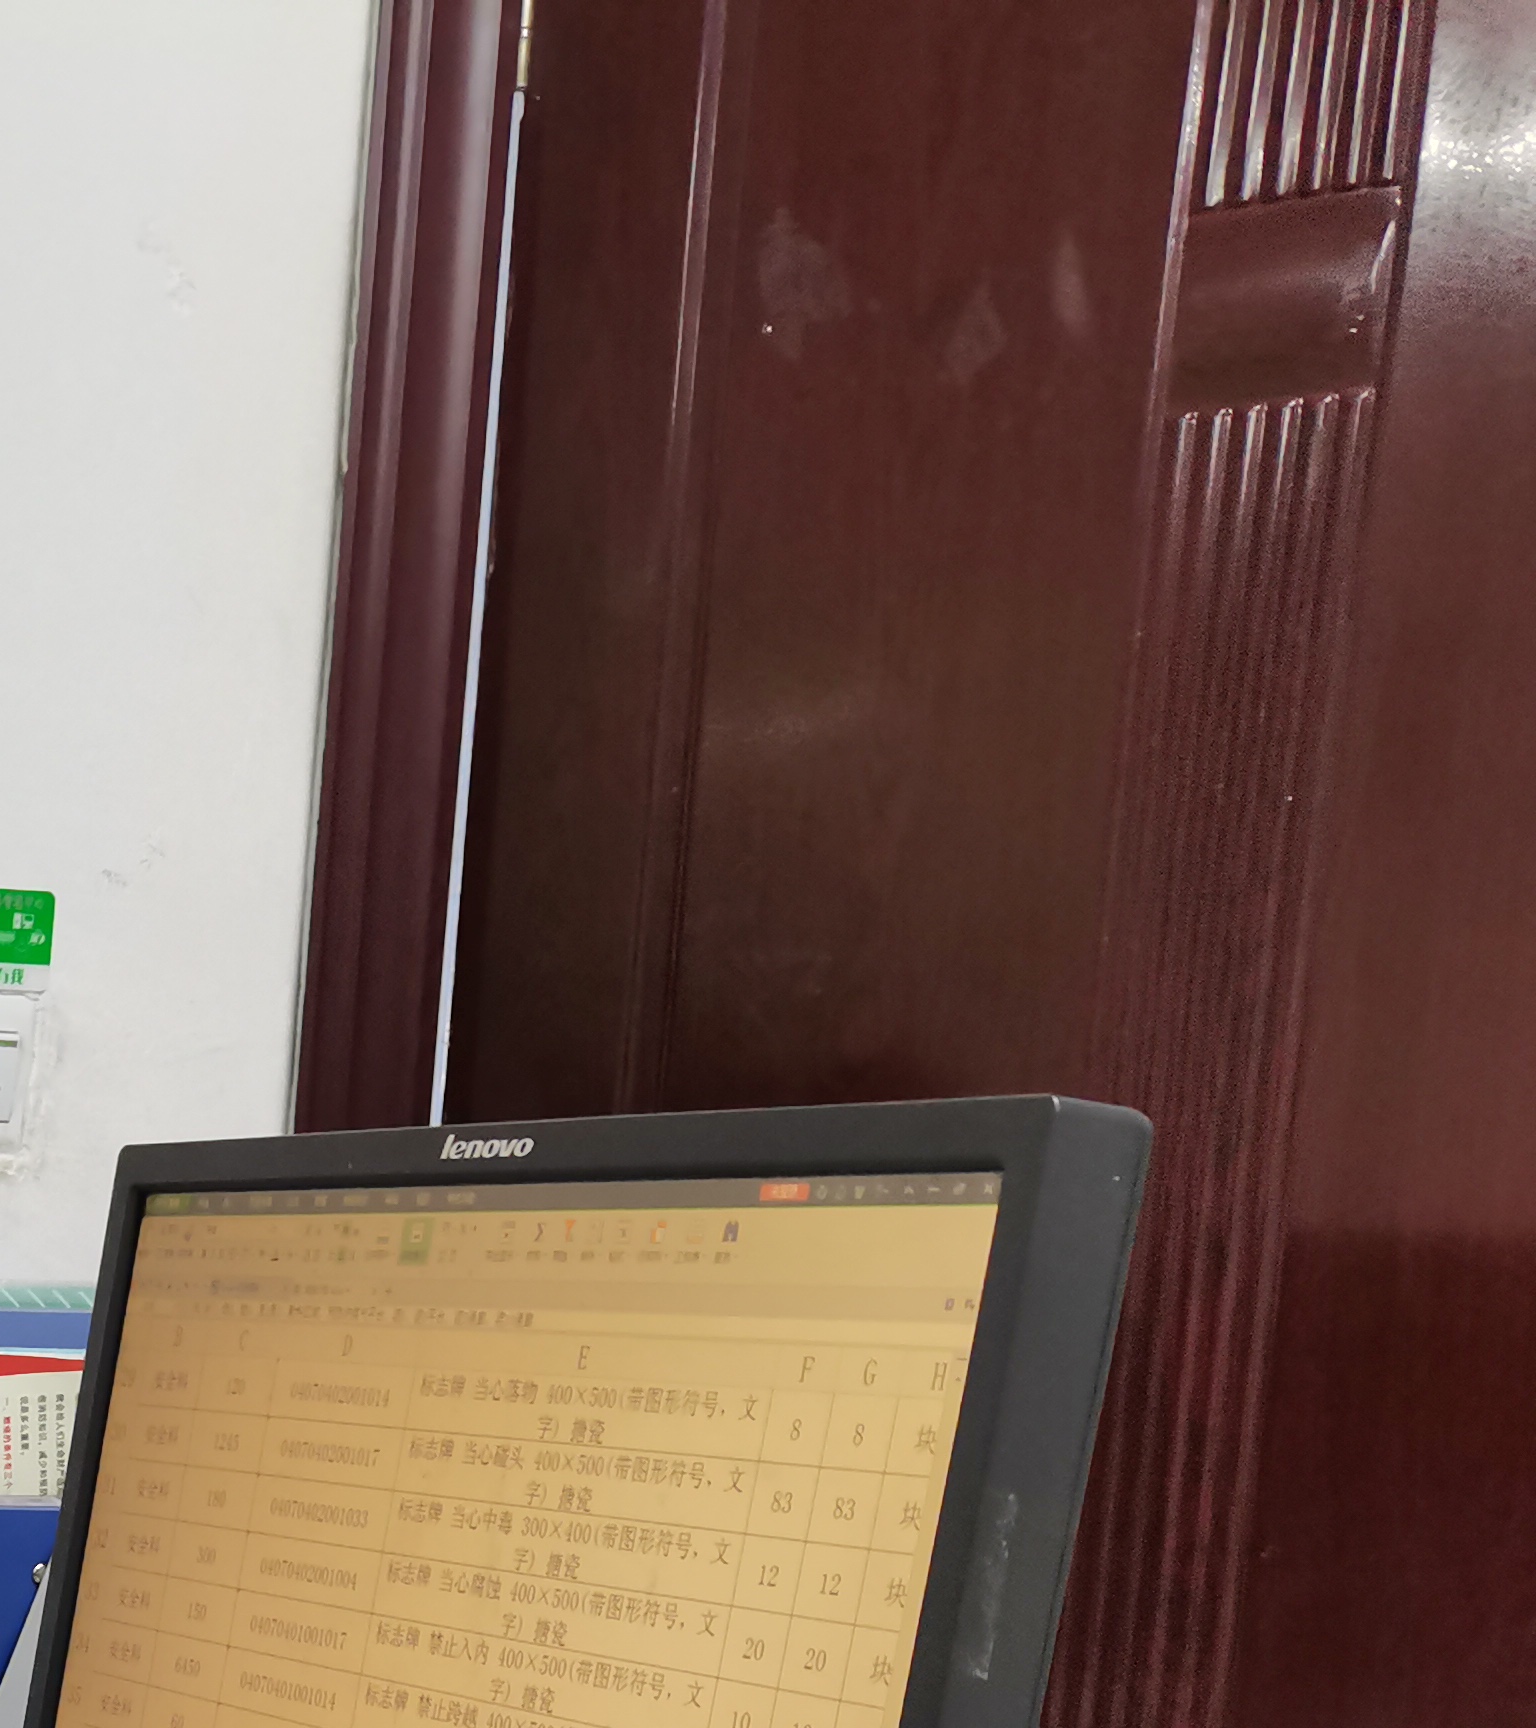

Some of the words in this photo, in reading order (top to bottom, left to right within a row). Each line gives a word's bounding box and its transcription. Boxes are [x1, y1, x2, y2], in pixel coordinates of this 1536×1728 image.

[439, 1133, 535, 1161] lenovo
[799, 1355, 816, 1384] F
[863, 1358, 878, 1387] G
[930, 1362, 948, 1391] H
[789, 1418, 802, 1441] 8
[852, 1423, 865, 1447] 8
[914, 1424, 937, 1455] 块
[770, 1491, 794, 1514] 83
[832, 1497, 856, 1521] 83
[899, 1501, 923, 1532] 块
[758, 1564, 780, 1588] 12
[819, 1573, 842, 1597] 12
[884, 1577, 908, 1609] 块
[428, 1629, 489, 1665] 禁止入内
[741, 1637, 765, 1661] 20
[803, 1648, 827, 1672] 20
[869, 1655, 894, 1687] 块
